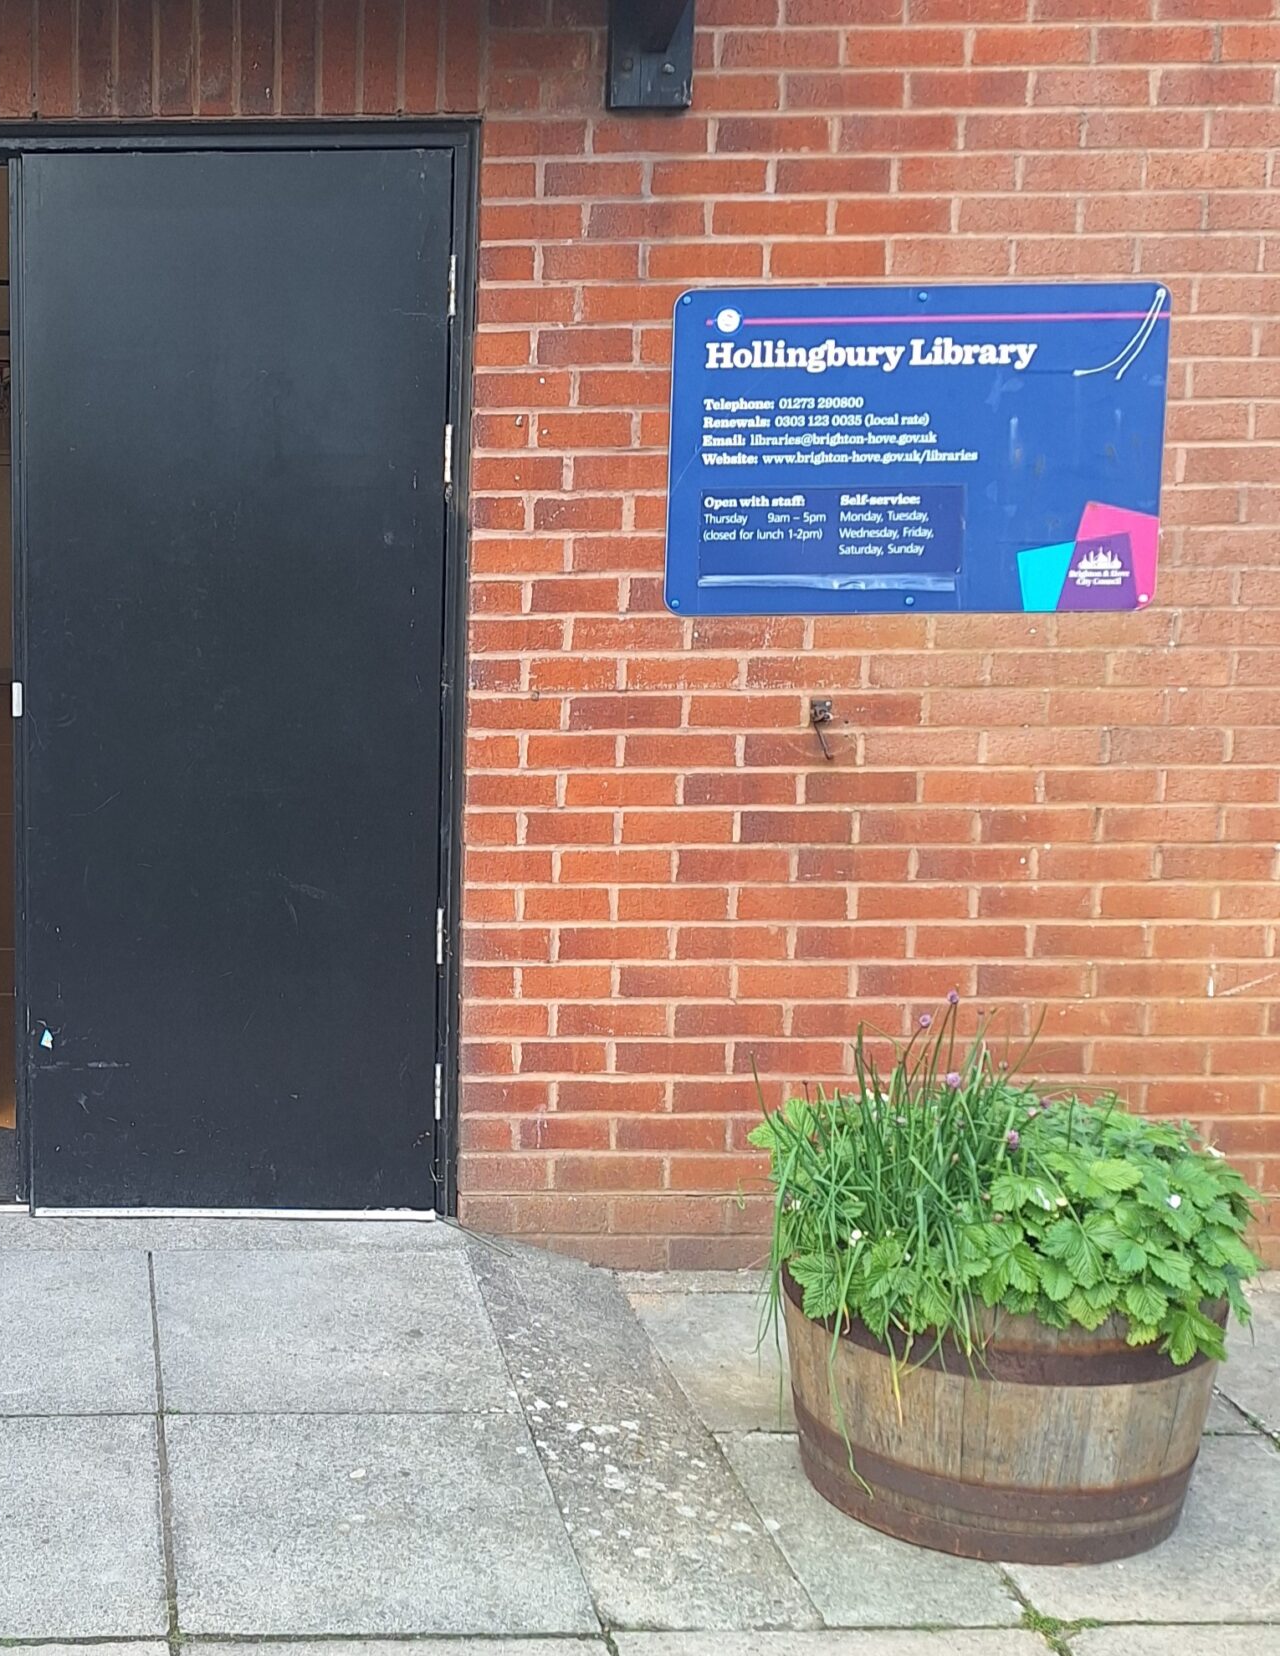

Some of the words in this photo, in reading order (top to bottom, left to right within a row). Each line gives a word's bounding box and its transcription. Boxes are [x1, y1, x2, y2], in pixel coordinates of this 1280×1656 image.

[704, 337, 904, 373] Hollingbury
[910, 337, 1038, 368] Library
[703, 398, 775, 412] Telephone:
[778, 397, 815, 409] 01273
[817, 396, 864, 409] 290800
[703, 416, 771, 429] Renewals:
[774, 415, 806, 427] 0303
[807, 414, 830, 427] 123
[832, 414, 862, 427] 0035
[864, 413, 899, 427] (local
[900, 413, 930, 427] rate)
[702, 434, 746, 447] Email:
[749, 431, 938, 447] libraries@brighton-hove.gov.uk
[702, 452, 758, 465] Website:
[762, 449, 978, 465] www.brighton-hove.gov.uk/libraries
[703, 496, 738, 510] Open
[739, 495, 770, 508] with
[771, 494, 806, 508] staff:
[839, 494, 921, 507] Self-service:
[703, 513, 748, 526] Thursday
[767, 512, 791, 524] 9am
[803, 512, 827, 526] 5pm
[839, 511, 884, 524] Monday,
[887, 510, 930, 524] Tuesday,
[702, 529, 736, 541] (closed
[739, 528, 754, 540] for
[756, 528, 784, 540] lunch
[787, 528, 823, 541] 1-2pm)
[838, 527, 900, 540] Wednesday,
[902, 526, 935, 540] Friday,
[838, 543, 884, 556] Saturday,
[887, 543, 925, 556] Sunday
